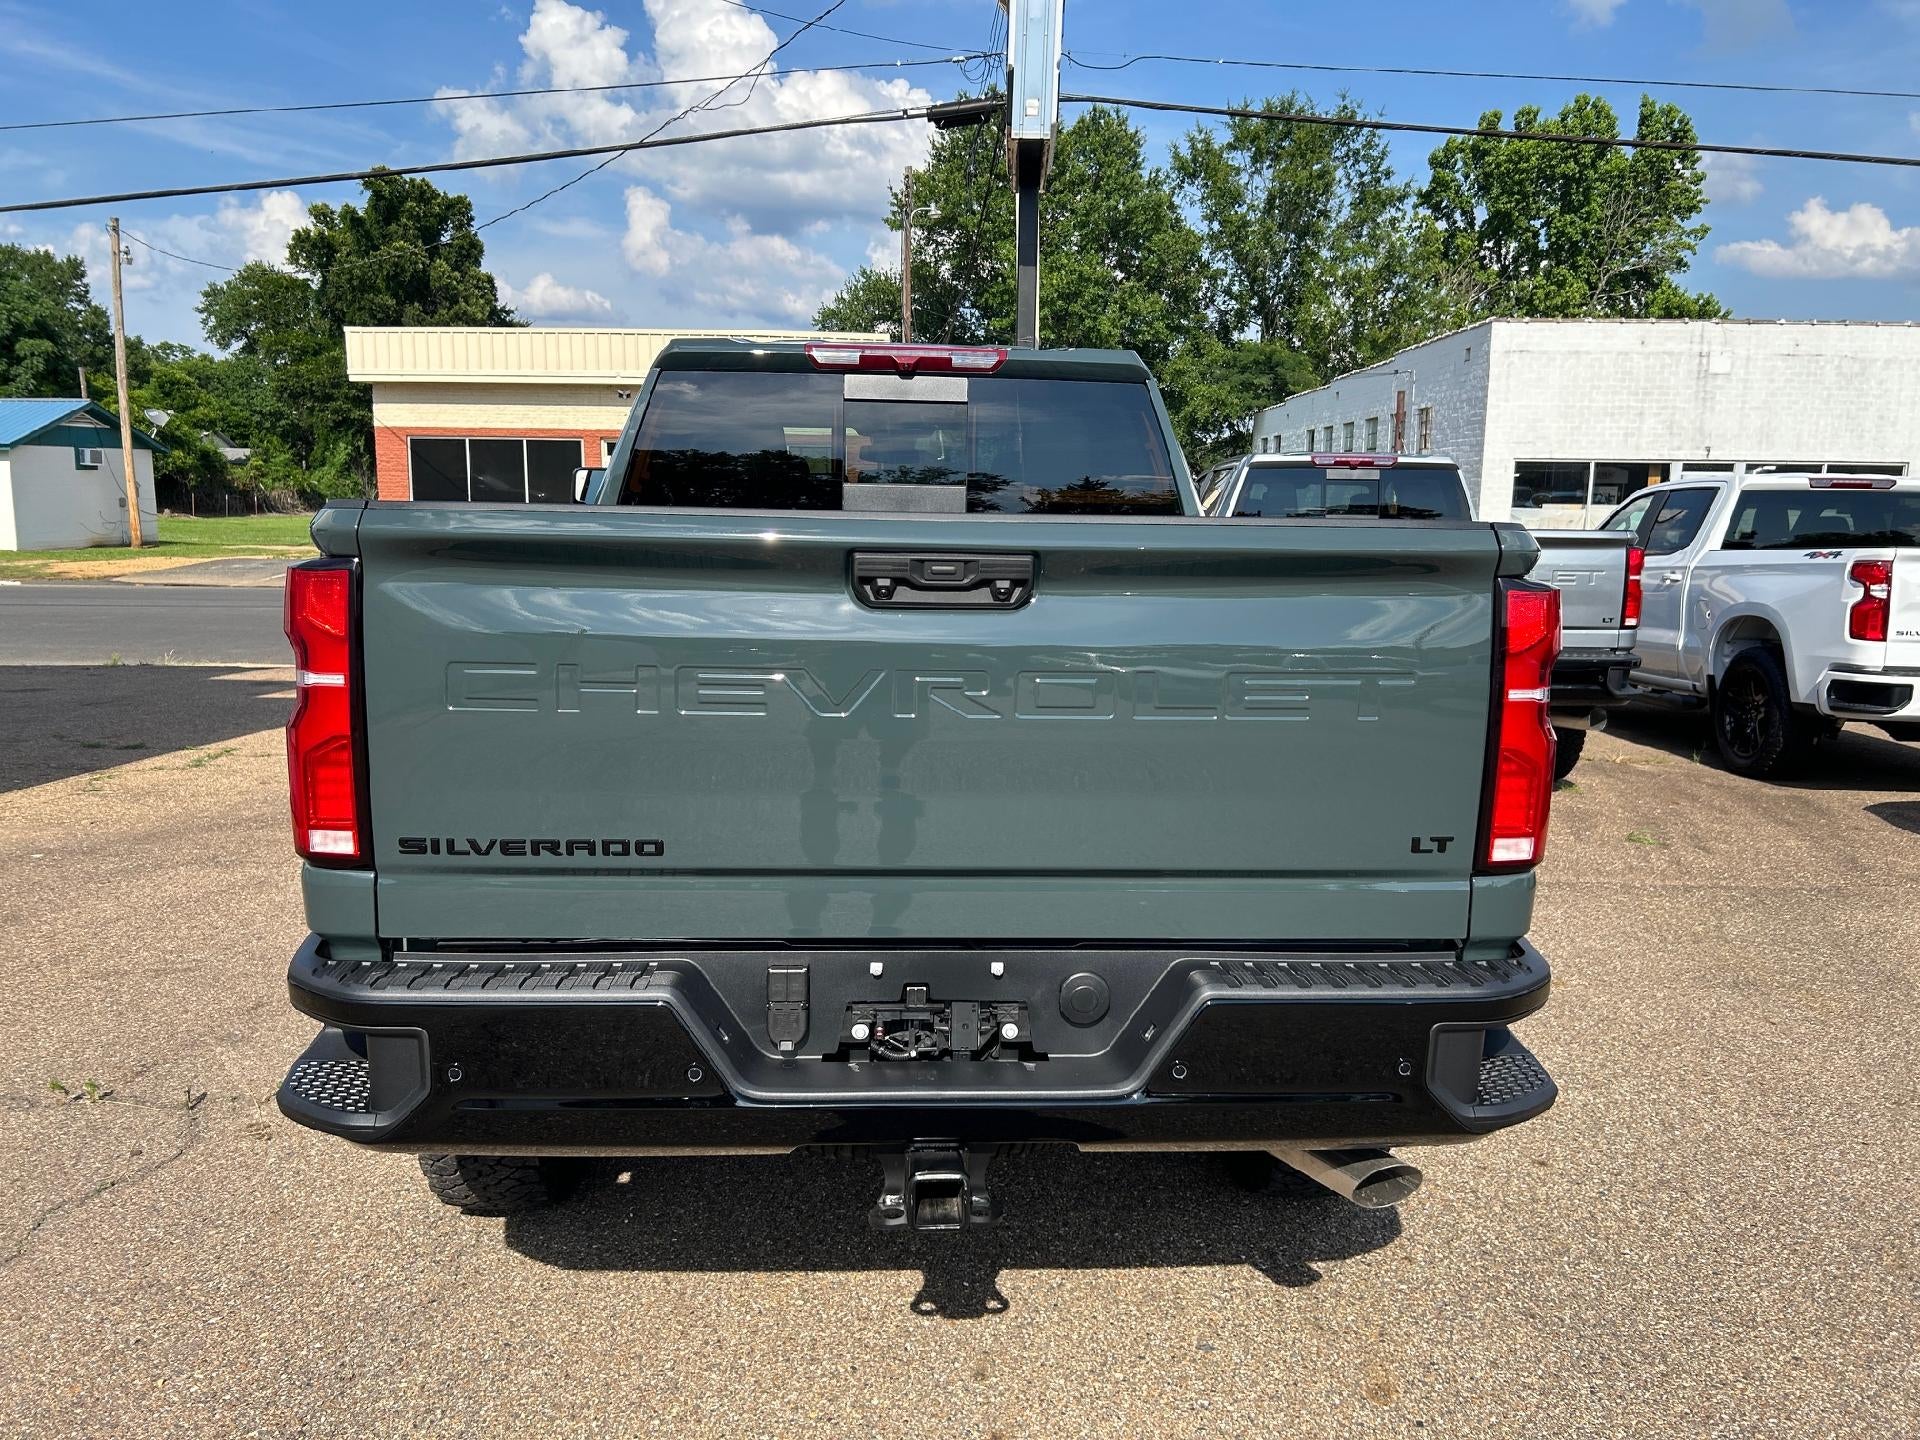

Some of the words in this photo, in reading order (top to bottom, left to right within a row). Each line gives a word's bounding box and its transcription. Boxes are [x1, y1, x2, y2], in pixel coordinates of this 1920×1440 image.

[444, 661, 1416, 721] CHEVROLET
[398, 837, 665, 857] SILVERADO
[1410, 836, 1455, 854] LT
